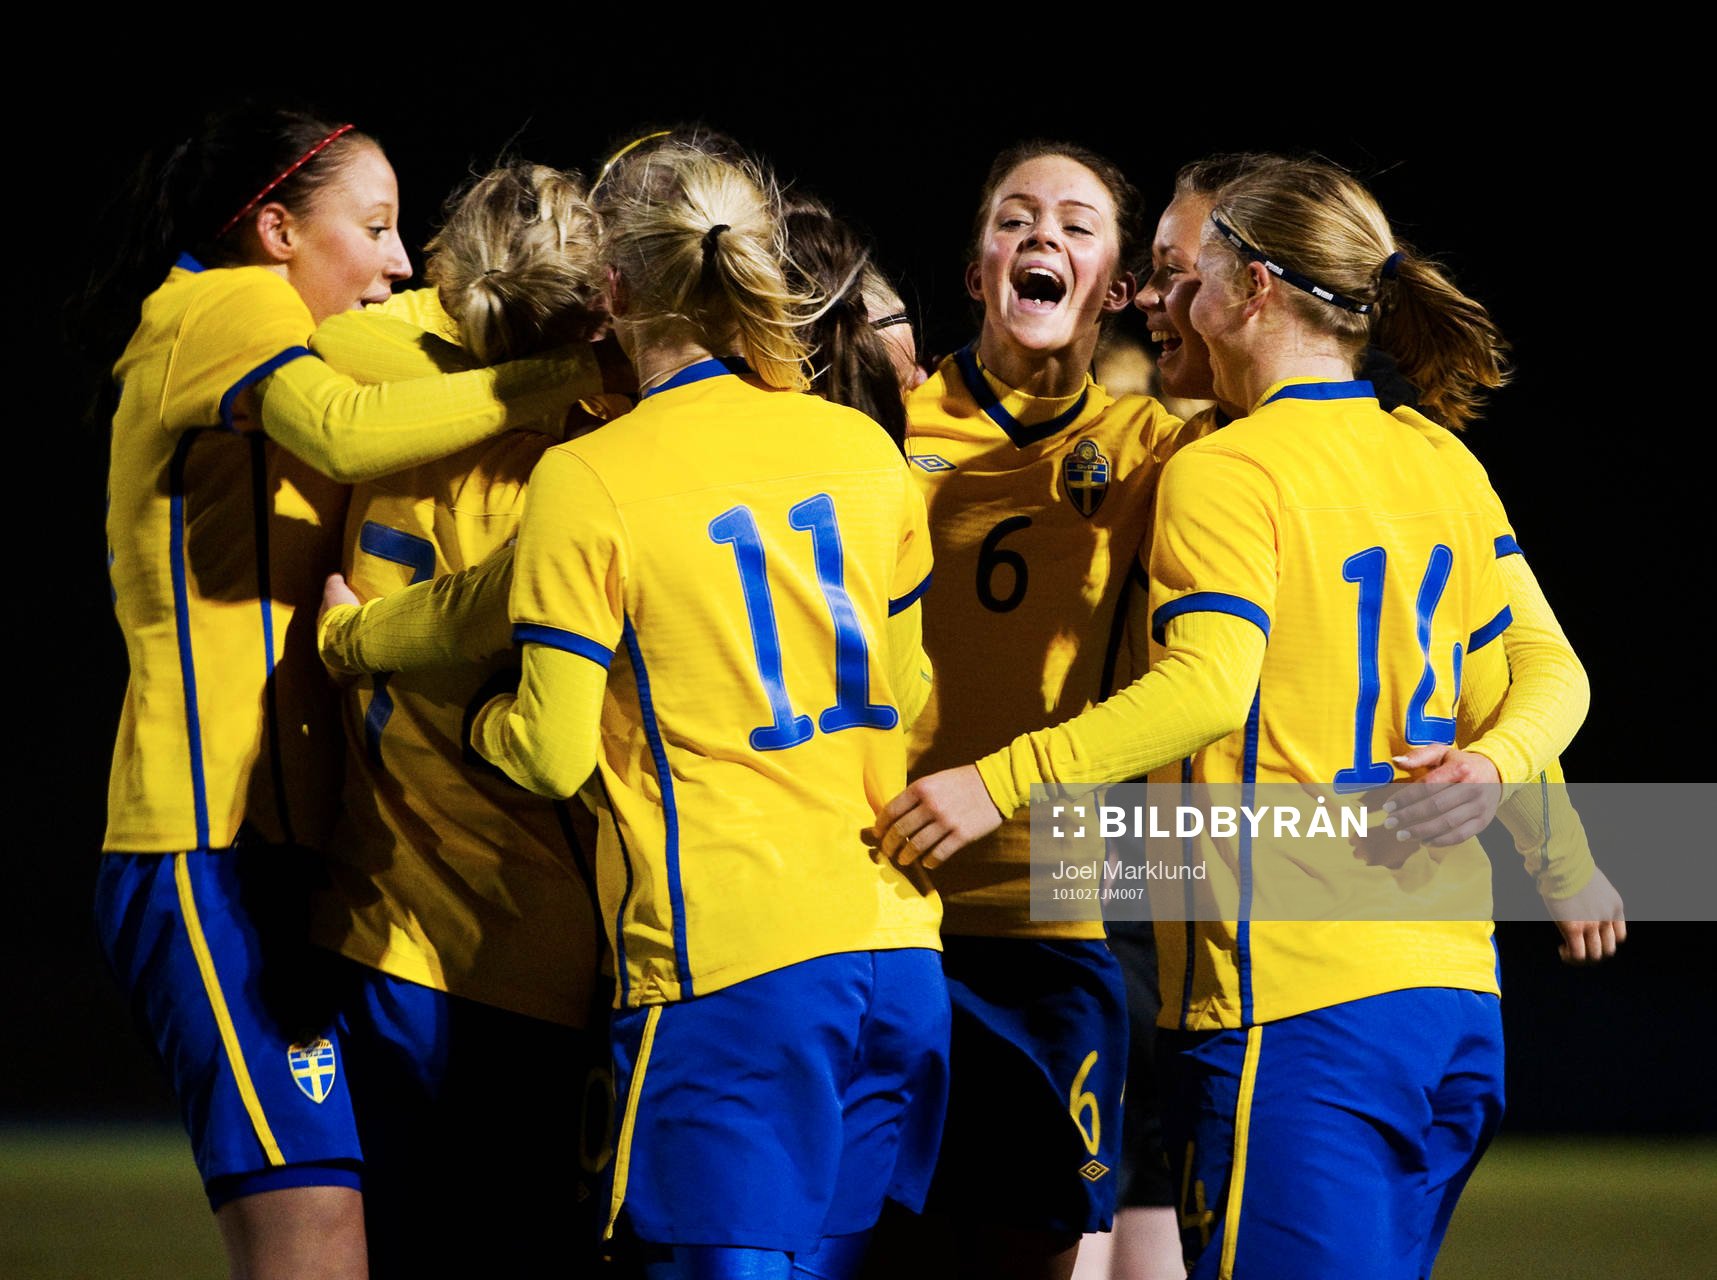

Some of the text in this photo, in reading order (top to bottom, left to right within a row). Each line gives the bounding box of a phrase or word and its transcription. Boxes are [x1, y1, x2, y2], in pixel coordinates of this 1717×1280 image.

[976, 515, 1033, 613] 6
[708, 493, 899, 751] 11
[1069, 1049, 1101, 1156] 6
